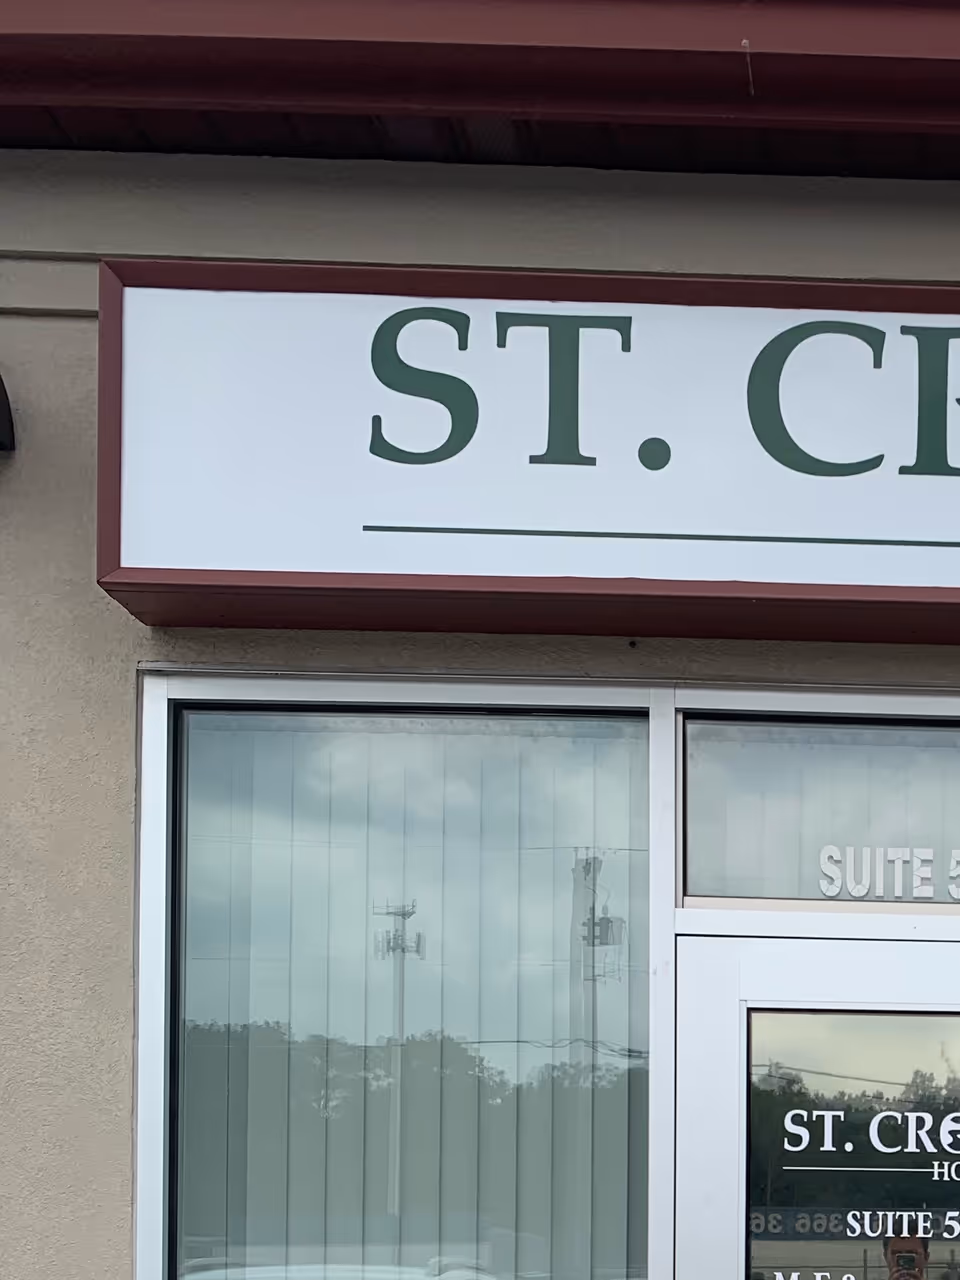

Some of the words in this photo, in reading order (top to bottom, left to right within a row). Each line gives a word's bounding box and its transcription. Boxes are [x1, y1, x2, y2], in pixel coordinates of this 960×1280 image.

[368, 306, 672, 471] ST.
[818, 845, 934, 899] SUITE
[783, 1109, 854, 1152] ST.
[846, 1210, 935, 1238] SUITE
